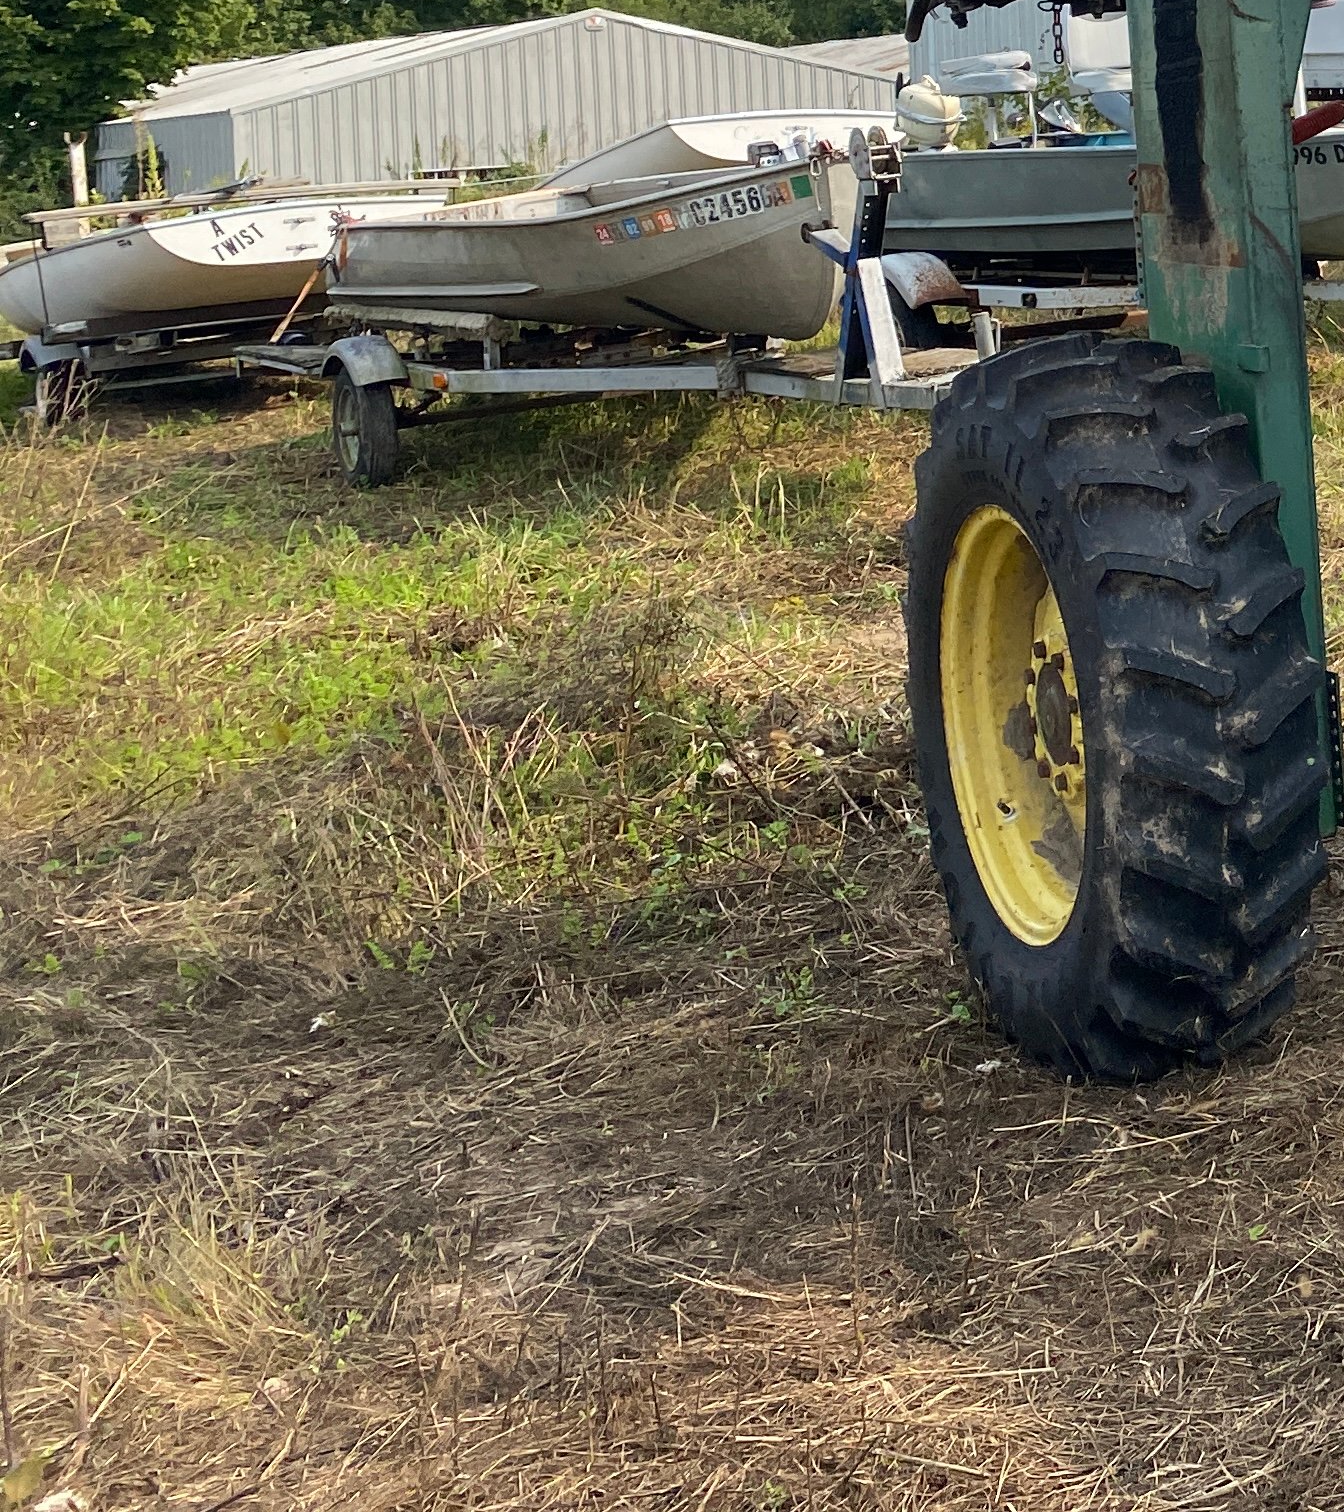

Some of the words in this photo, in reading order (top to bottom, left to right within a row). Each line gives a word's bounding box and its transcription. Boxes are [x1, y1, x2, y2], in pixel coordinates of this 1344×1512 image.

[210, 219, 225, 238] A
[657, 212, 673, 227] 18
[211, 222, 264, 261] TWIST
